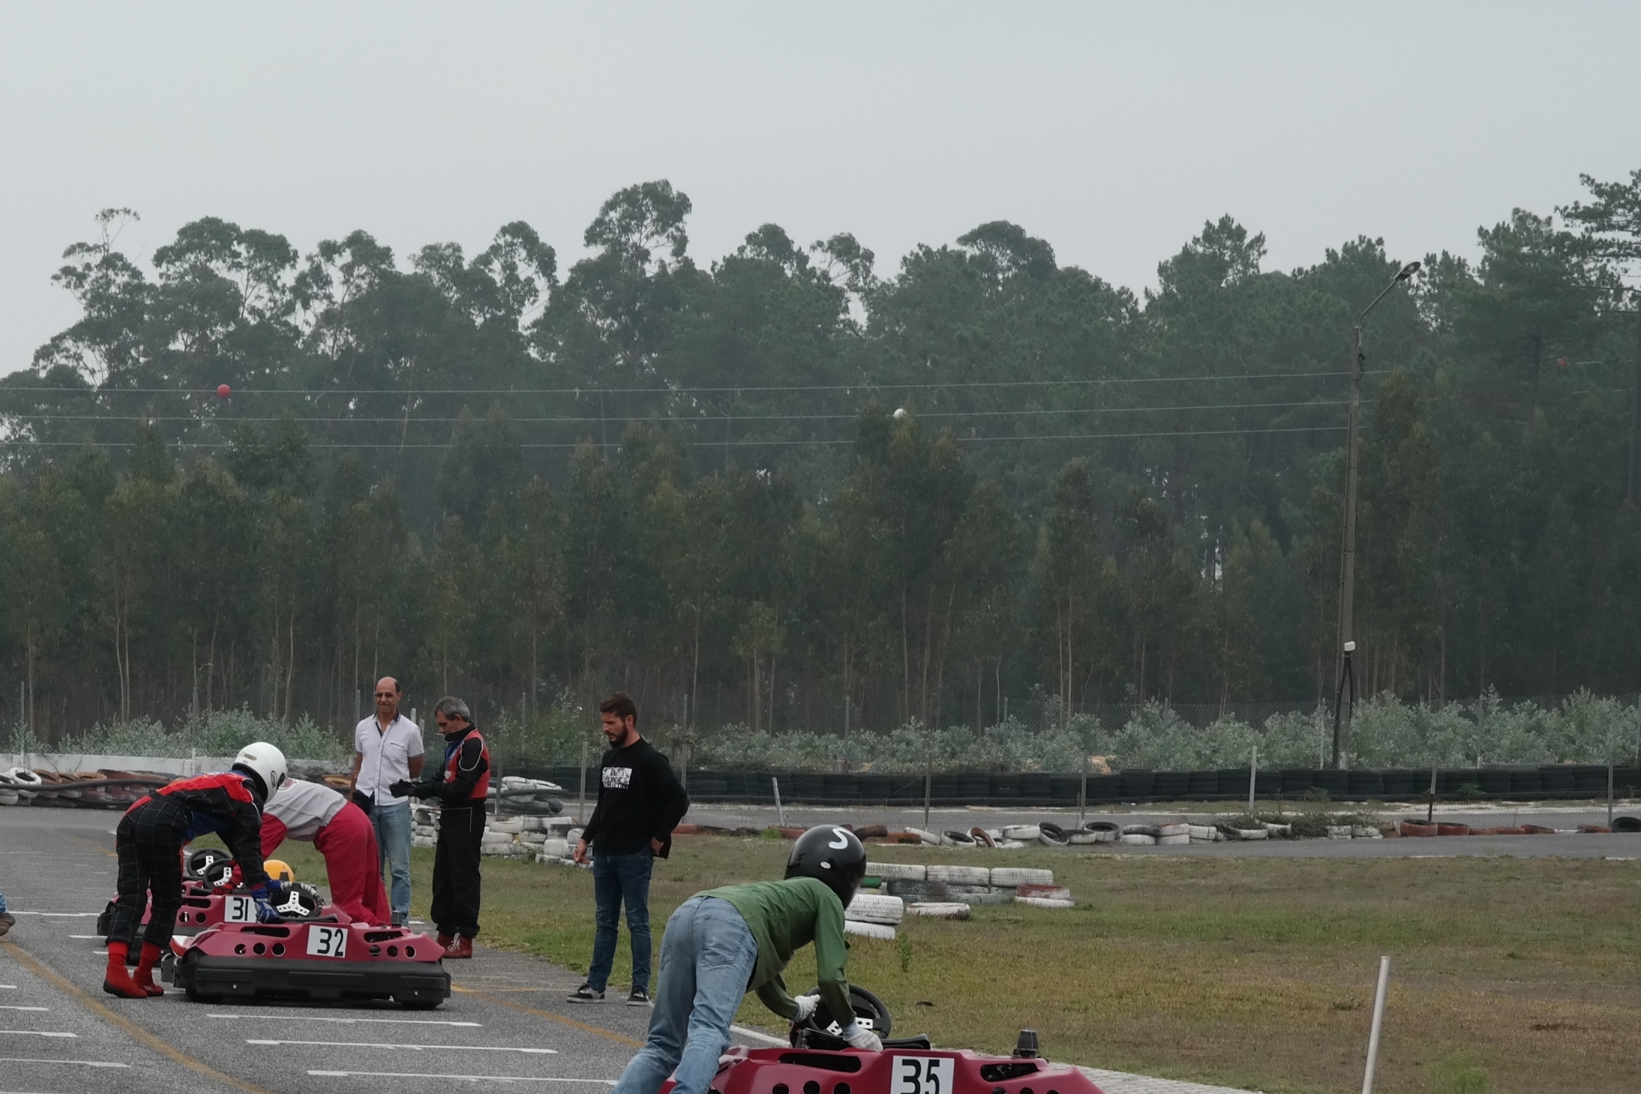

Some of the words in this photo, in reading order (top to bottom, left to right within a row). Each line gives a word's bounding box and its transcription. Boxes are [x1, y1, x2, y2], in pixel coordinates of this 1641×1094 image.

[828, 828, 855, 849] S
[231, 897, 249, 921] 31
[316, 928, 344, 957] 32
